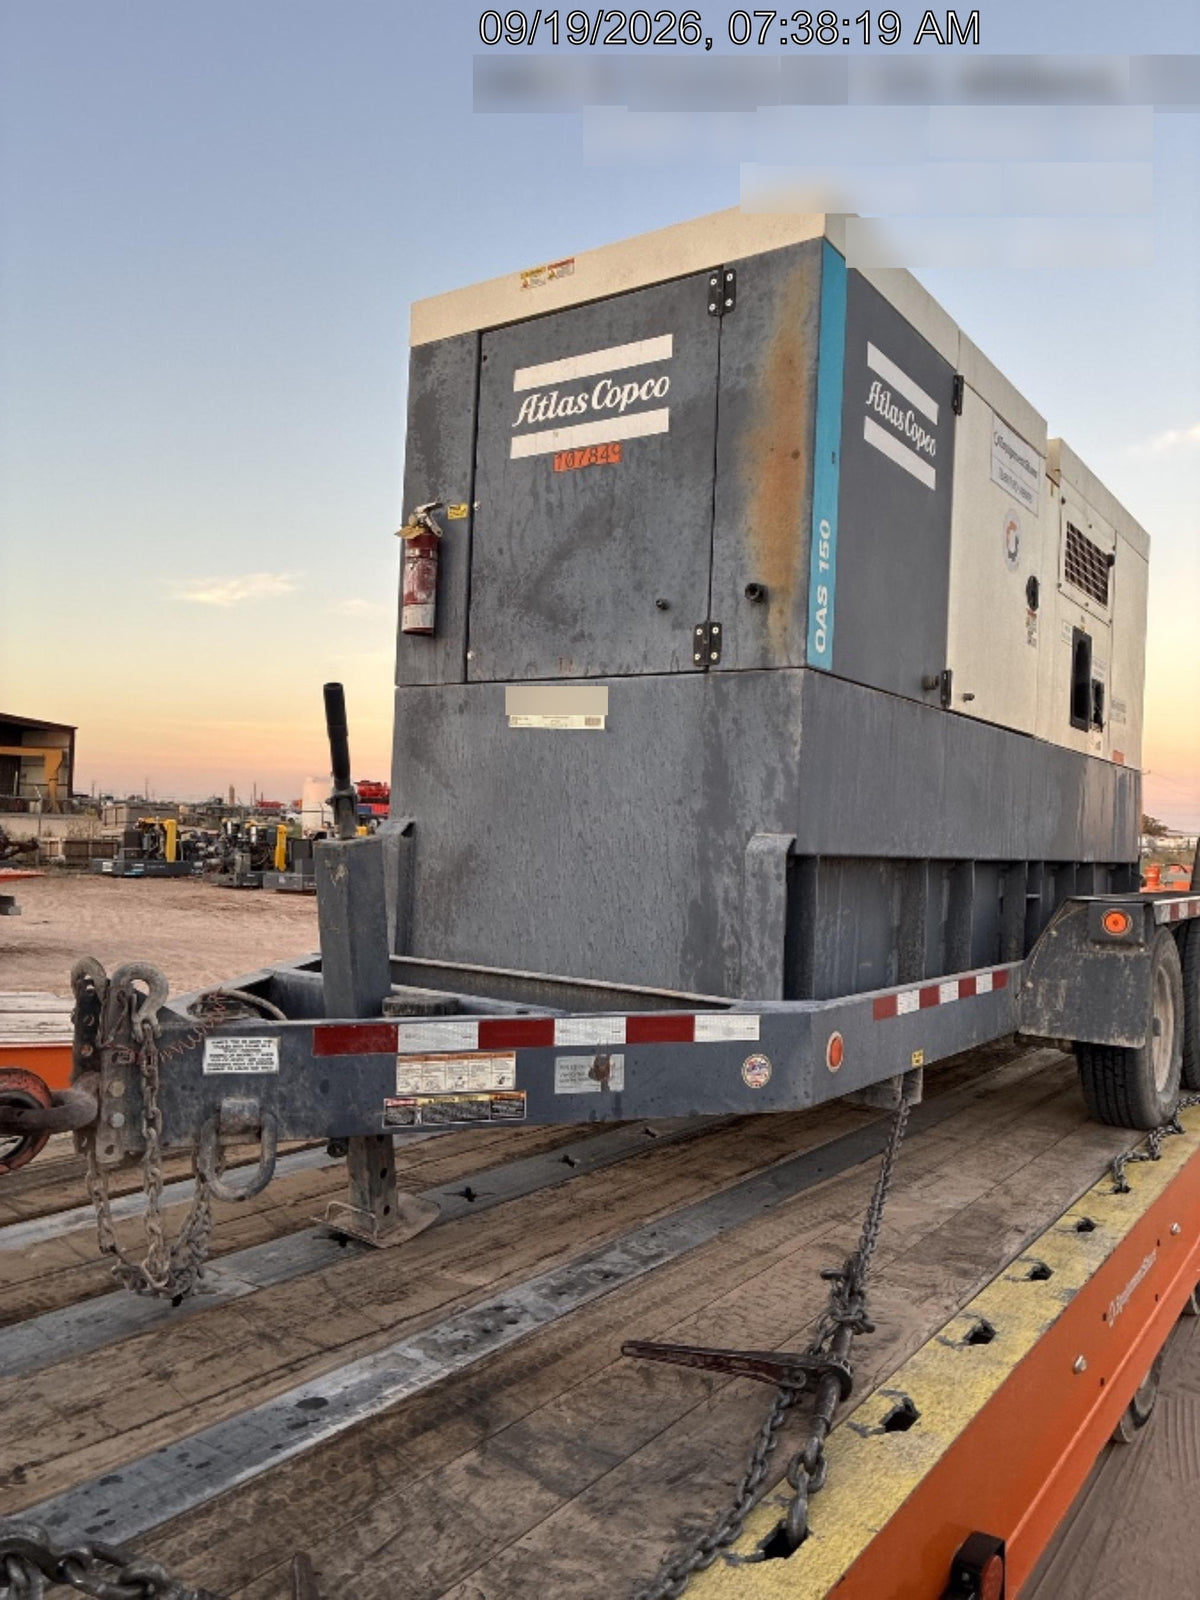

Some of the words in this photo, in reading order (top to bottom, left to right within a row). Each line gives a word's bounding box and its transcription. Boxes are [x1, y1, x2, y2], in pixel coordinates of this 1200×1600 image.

[511, 390, 589, 428] Atlas
[591, 376, 670, 413] Copco
[865, 381, 905, 431] Atlas
[904, 410, 937, 457] Copco
[818, 518, 831, 574] 150
